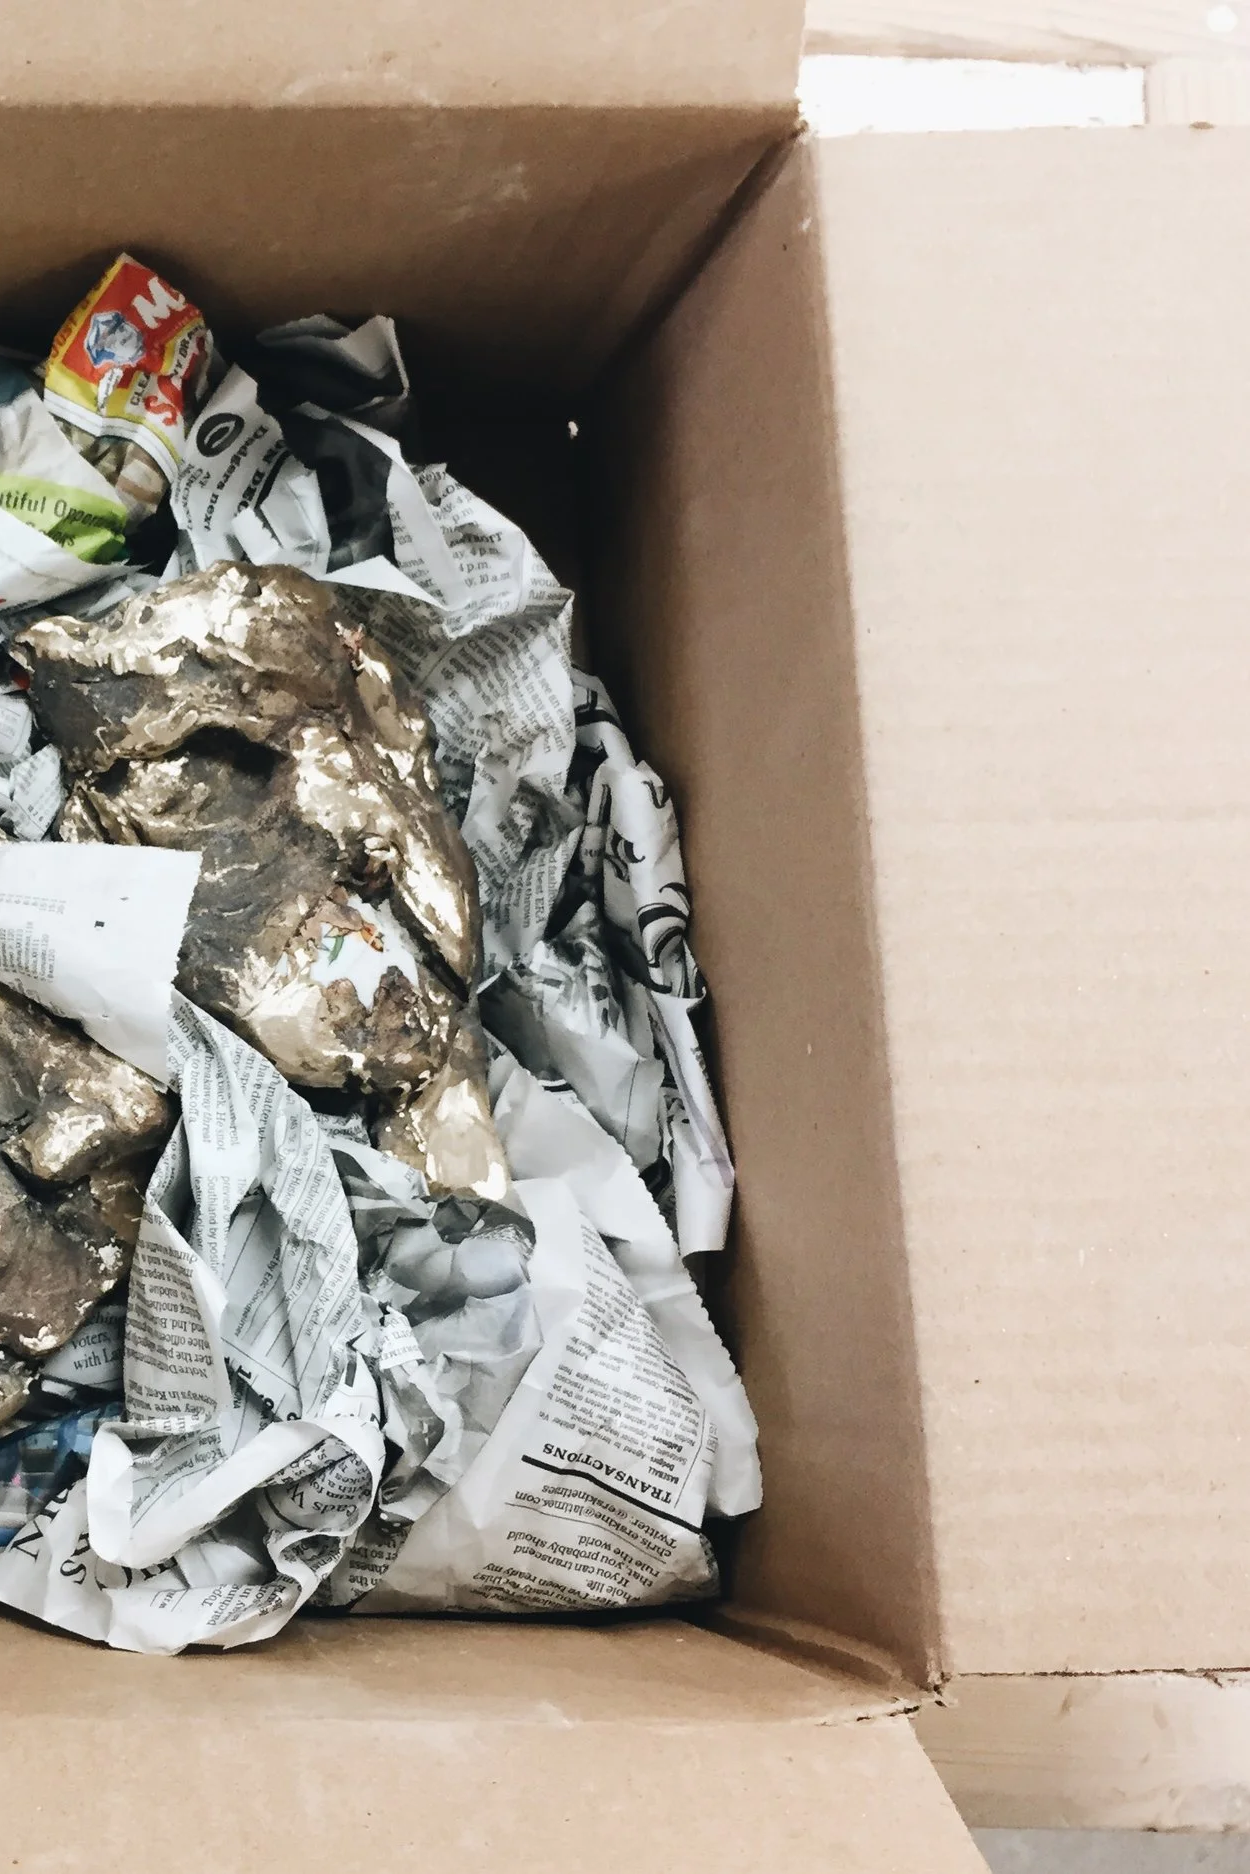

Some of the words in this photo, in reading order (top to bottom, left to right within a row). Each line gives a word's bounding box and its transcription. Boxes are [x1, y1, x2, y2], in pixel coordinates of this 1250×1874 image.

[217, 427, 267, 490] Dodgers
[234, 470, 264, 517] DEC
[200, 493, 222, 531] next
[534, 897, 546, 923] ERA
[189, 1071, 200, 1100] break
[202, 1056, 212, 1108] breakaway
[201, 1112, 214, 1143] threat
[206, 1177, 216, 1224] Southland
[220, 1176, 232, 1211] preview
[260, 1272, 274, 1288] Eric
[318, 1287, 334, 1306] City
[74, 1351, 101, 1370] with
[176, 1350, 192, 1362] the
[176, 1365, 207, 1378] Notre
[544, 1444, 671, 1503] TRANSACTIONS
[507, 1528, 547, 1549] should
[578, 1532, 612, 1552] world.
[514, 1544, 572, 1571] transcend
[547, 1536, 600, 1568] probably
[612, 1548, 634, 1564] the
[483, 1561, 503, 1574] my
[574, 1561, 595, 1574] can
[600, 1555, 625, 1570] you
[634, 1560, 660, 1578] rule
[472, 1568, 502, 1588] this?
[596, 1566, 619, 1581] you
[622, 1565, 656, 1588] that,
[538, 1578, 567, 1593] been
[584, 1578, 604, 1593] life.
